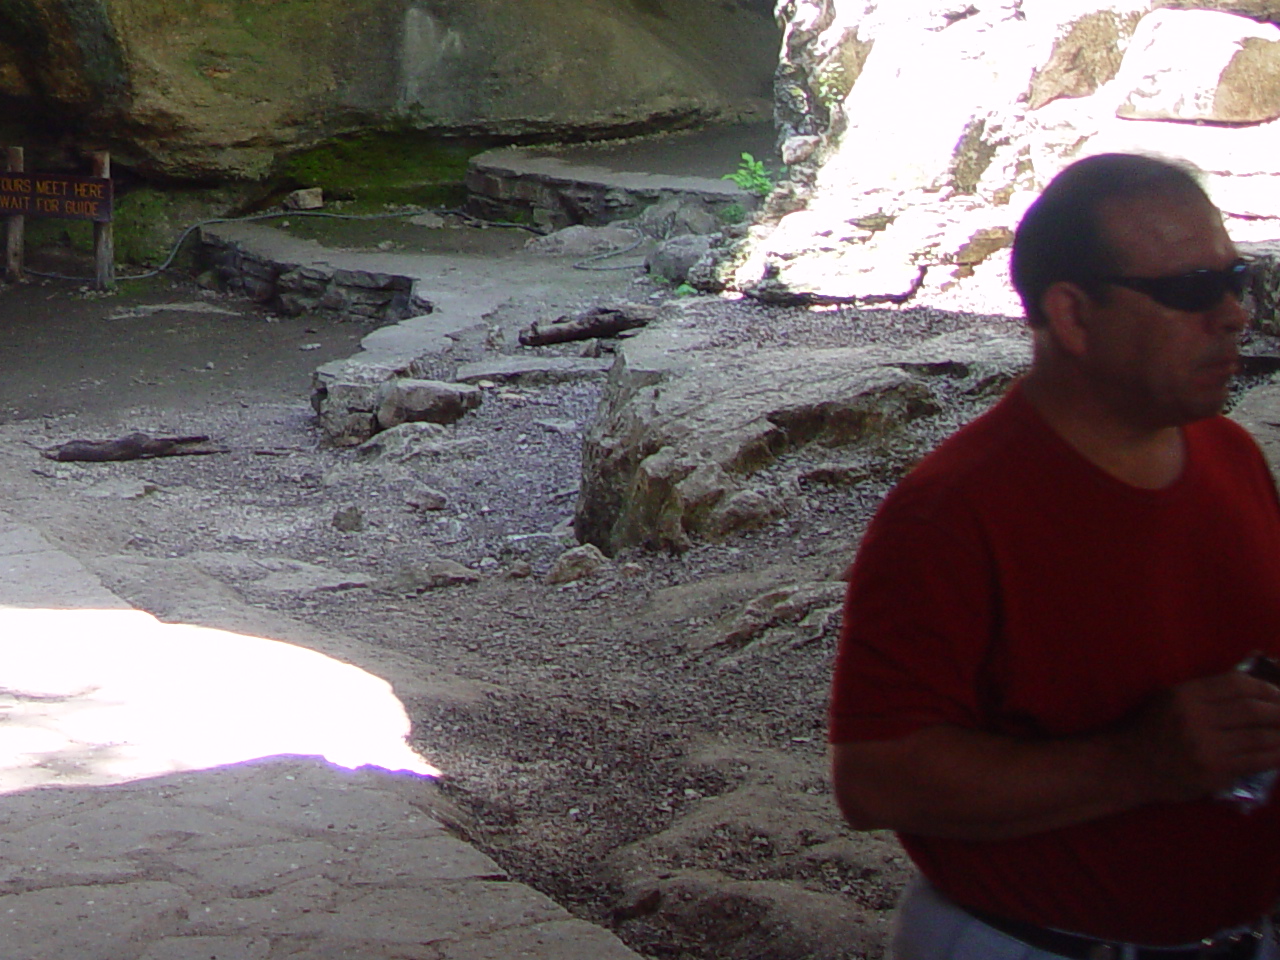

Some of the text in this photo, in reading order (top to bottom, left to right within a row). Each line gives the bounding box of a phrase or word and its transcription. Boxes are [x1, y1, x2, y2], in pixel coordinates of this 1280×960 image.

[36, 180, 68, 196] MEET
[74, 183, 105, 199] HERE
[0, 194, 100, 216] WAIT FOR GUIDE
